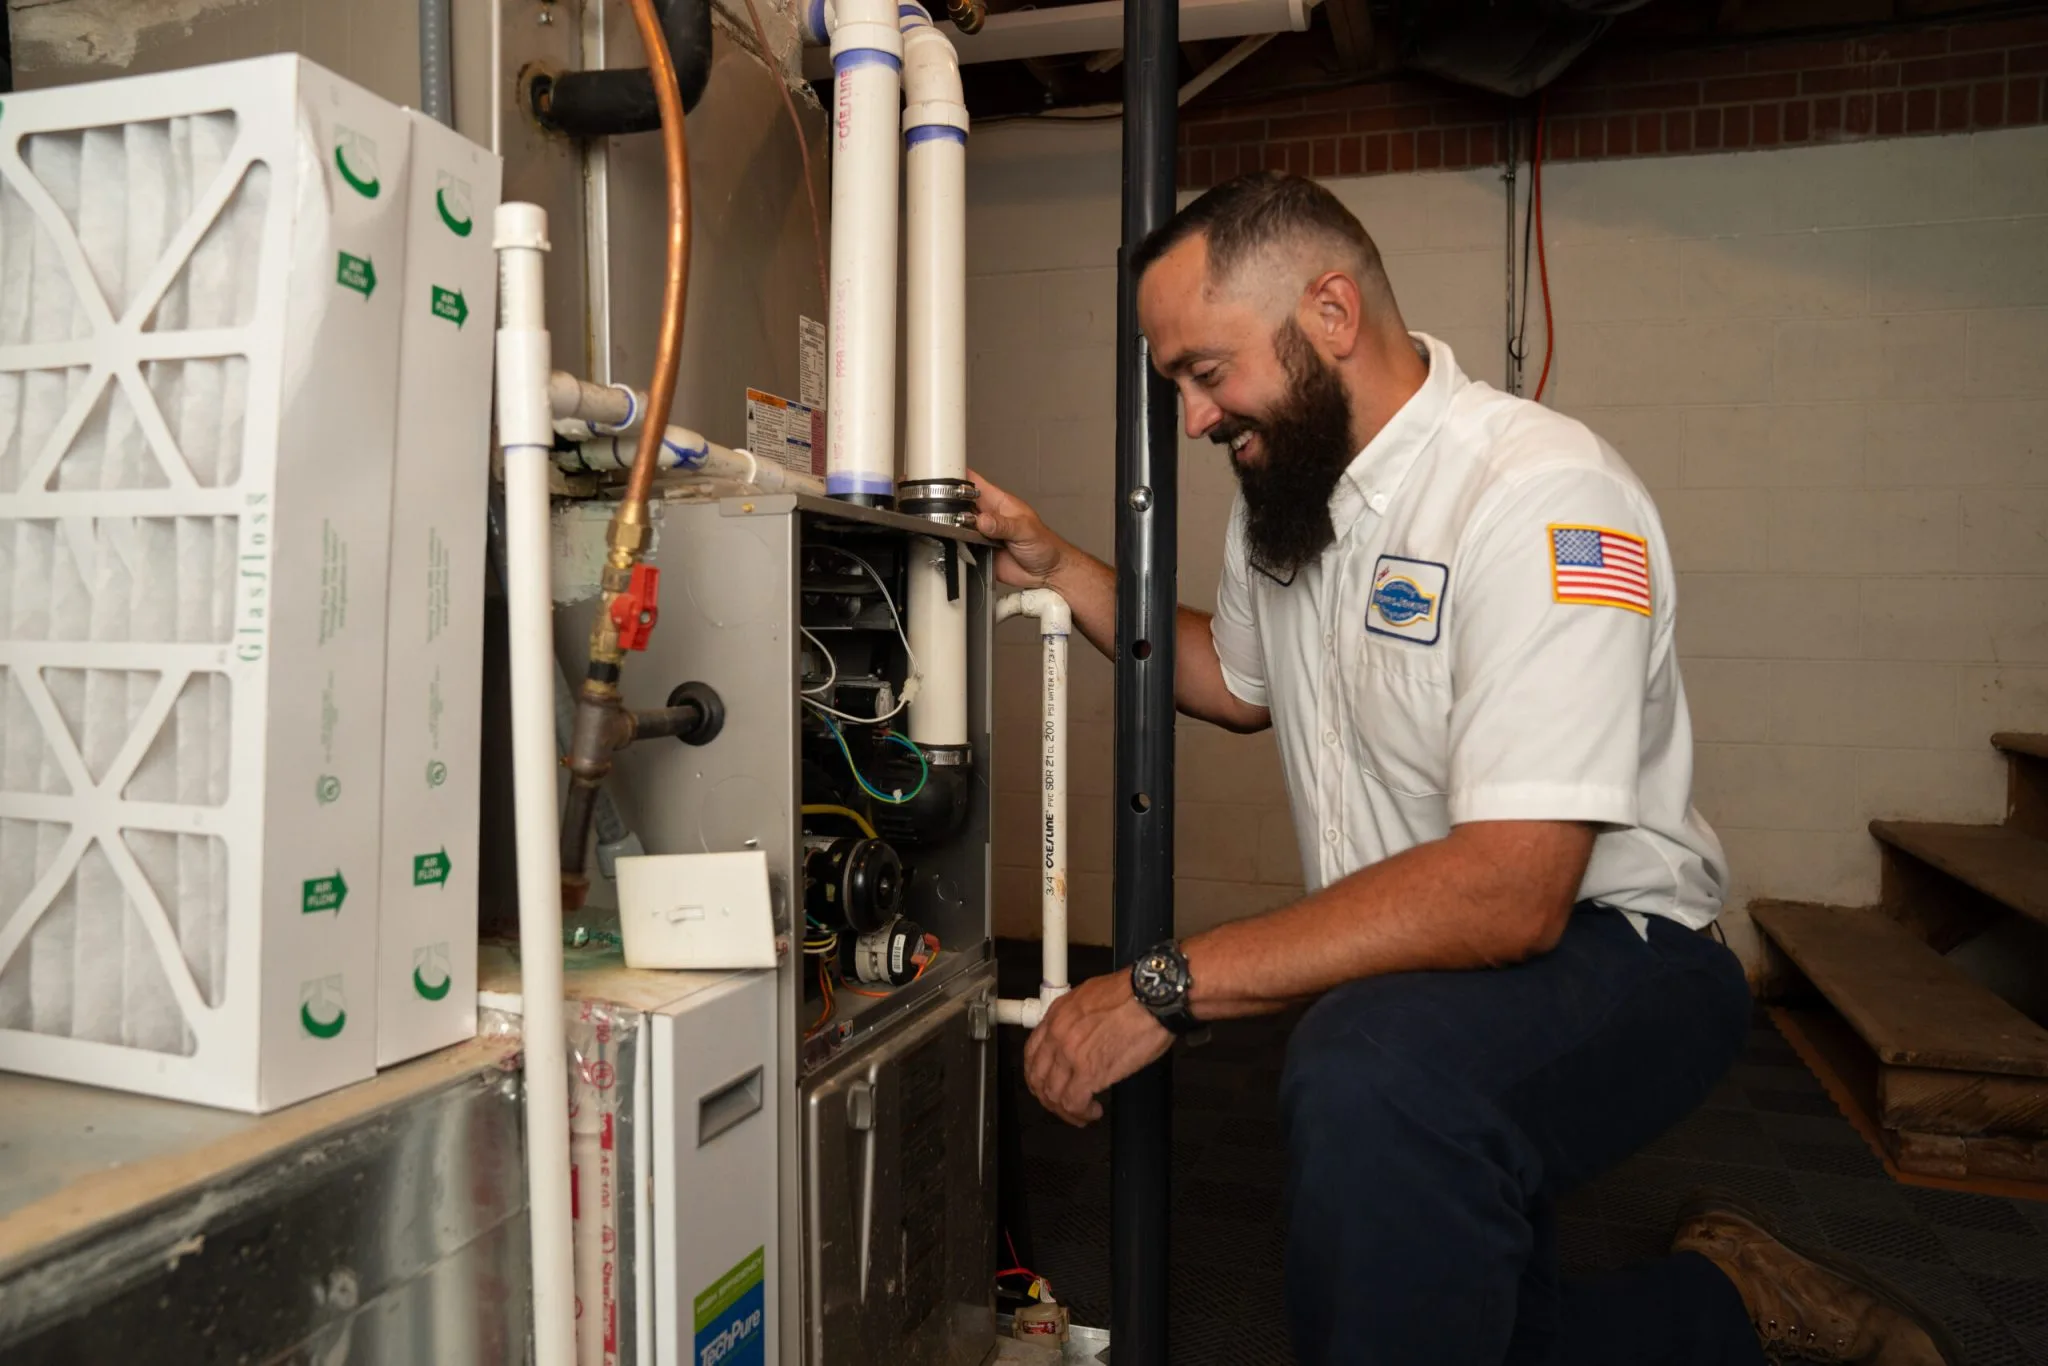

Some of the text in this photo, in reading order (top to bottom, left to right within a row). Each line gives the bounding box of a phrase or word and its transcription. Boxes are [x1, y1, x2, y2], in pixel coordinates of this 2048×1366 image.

[1048, 666, 1055, 676] AT
[1047, 677, 1055, 702] WATER
[1047, 703, 1055, 717] PSI
[1045, 720, 1055, 741] 200
[1045, 755, 1055, 767] 21
[1045, 769, 1055, 790] SDR
[423, 857, 438, 867] AIR
[417, 868, 443, 880] FLOW
[313, 881, 333, 893] AIR
[306, 893, 338, 907] FLOW
